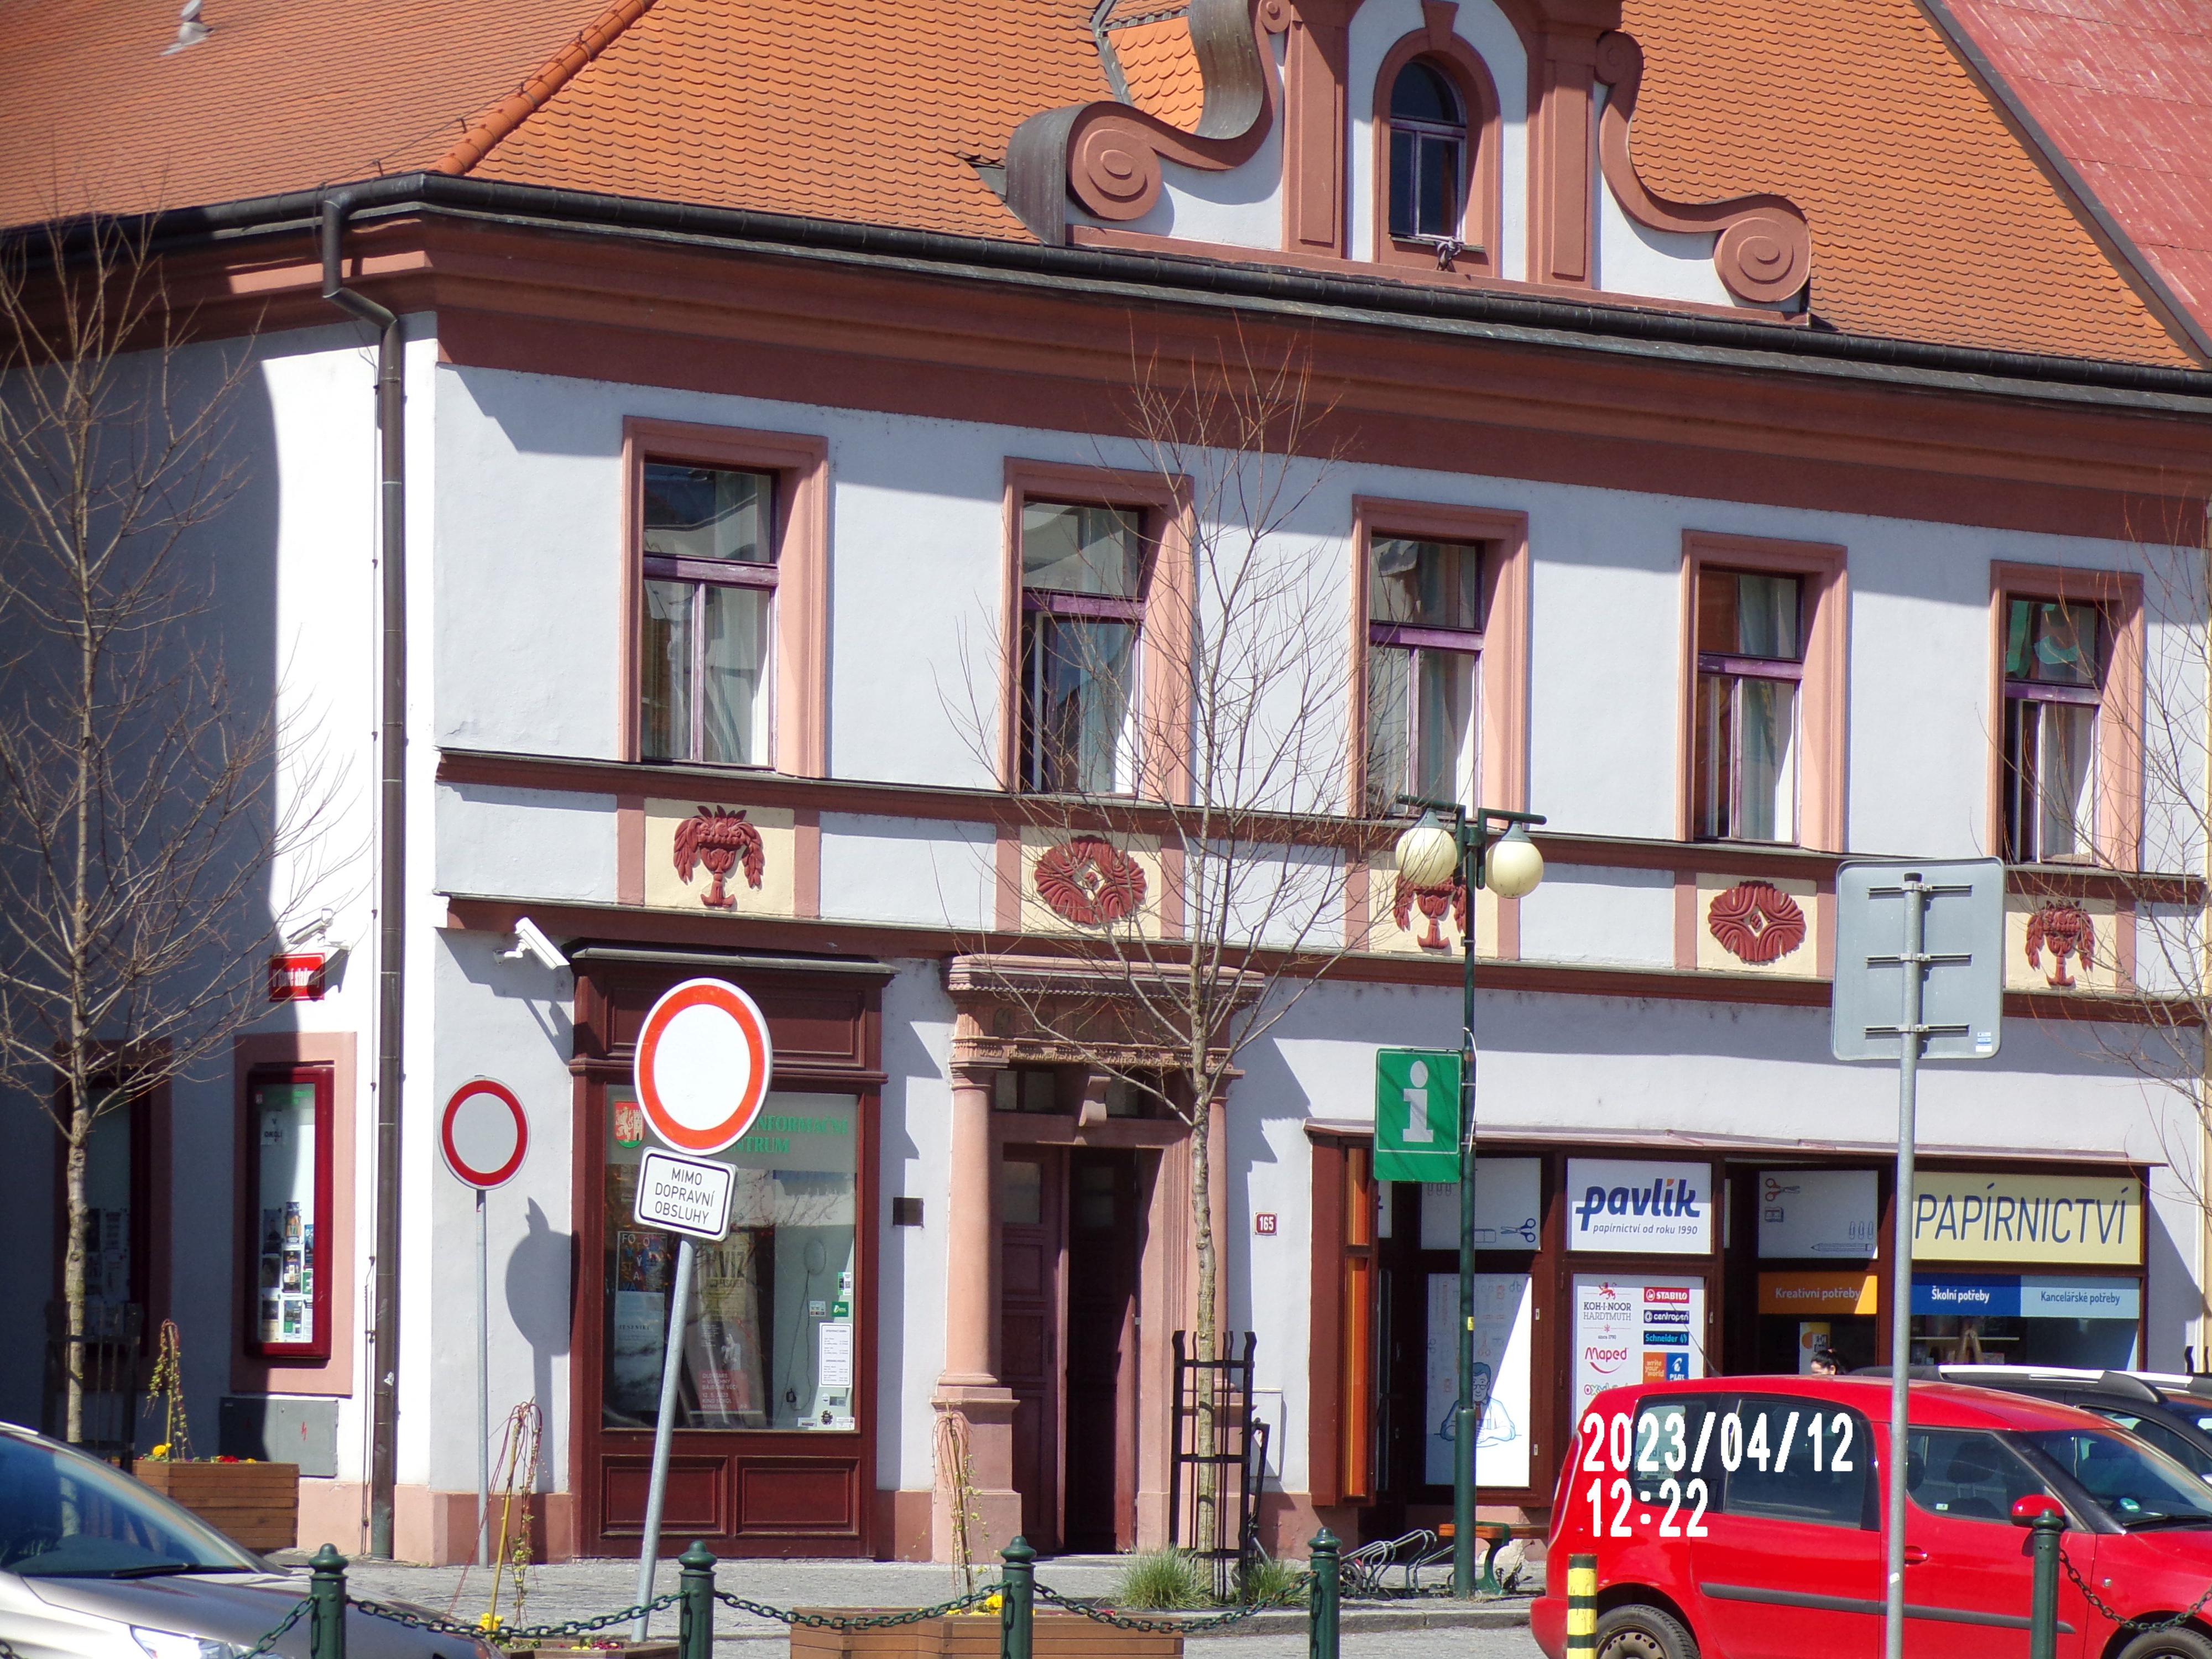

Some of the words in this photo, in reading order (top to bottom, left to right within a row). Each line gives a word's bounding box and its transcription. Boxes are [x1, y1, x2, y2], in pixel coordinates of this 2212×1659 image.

[671, 1167, 702, 1186] MIMO
[655, 1182, 715, 1207] DOPRAVNÍ
[655, 1201, 709, 1225] OBSLUHY
[1915, 1182, 2129, 1244] PAPÍRNICTVÍ
[1259, 1216, 1274, 1231] 165
[1593, 1223, 1641, 1234] papírnictví
[1642, 1224, 1653, 1234] od
[1656, 1225, 1675, 1234] roku
[1678, 1225, 1698, 1235] 1990
[1656, 1291, 1687, 1300] STABILO
[1775, 1287, 1820, 1298] Kreativní
[1822, 1287, 1861, 1301] potřeby
[1932, 1286, 1958, 1300] Školní
[1958, 1289, 1990, 1304] potřeby
[2041, 1291, 2088, 1302] Kancelářské
[2089, 1292, 2120, 1306] potřeby
[1583, 1302, 1631, 1311] KOH-I-NOOR
[1583, 1312, 1631, 1321] HARDTMUTH
[1653, 1312, 1689, 1322] centropen
[1645, 1334, 1678, 1342] Schneider
[1585, 1347, 1627, 1363] Maped
